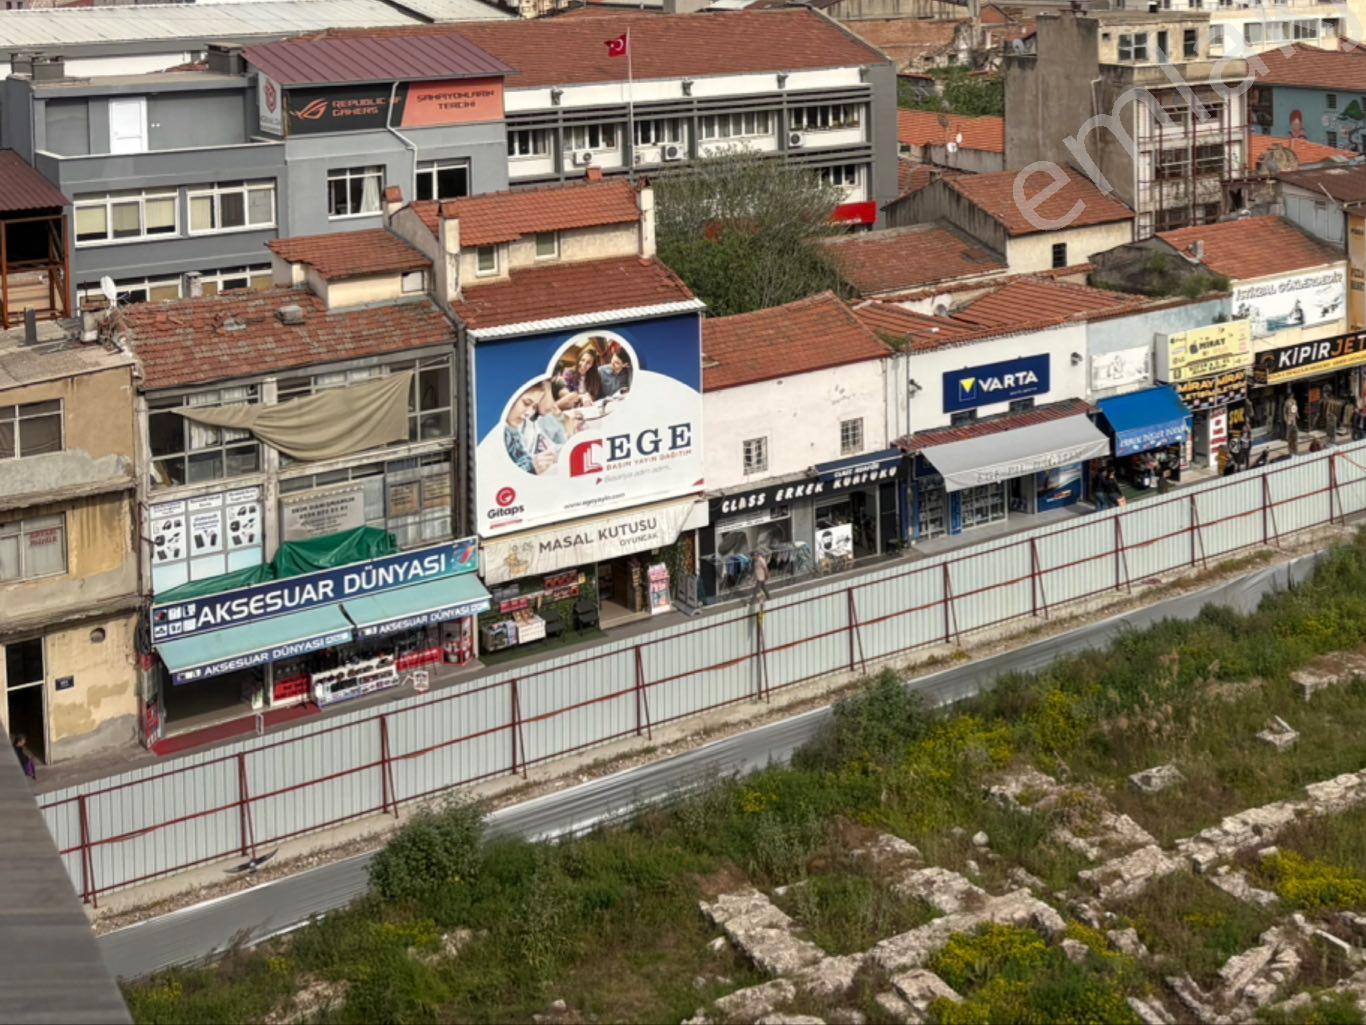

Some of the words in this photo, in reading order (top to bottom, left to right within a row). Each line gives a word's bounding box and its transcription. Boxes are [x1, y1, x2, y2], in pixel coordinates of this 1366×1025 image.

[332, 96, 386, 108] REPUBLIC
[332, 106, 379, 118] GAMERS
[978, 370, 1039, 393] VARTA
[606, 422, 691, 463] EGE
[487, 504, 525, 520] Gitaps
[721, 492, 767, 514] CLASS
[775, 481, 824, 502] ERKEK
[538, 533, 594, 554] MASAL
[598, 517, 657, 541] KUTUSU
[197, 579, 335, 627] AKSESUAR
[343, 552, 446, 594] DÜNYASI
[379, 614, 429, 635] AKSESUAR
[430, 604, 470, 622] DÜNYASI
[203, 651, 270, 676] AKSESUAR
[272, 637, 324, 659] DÜNYASI
